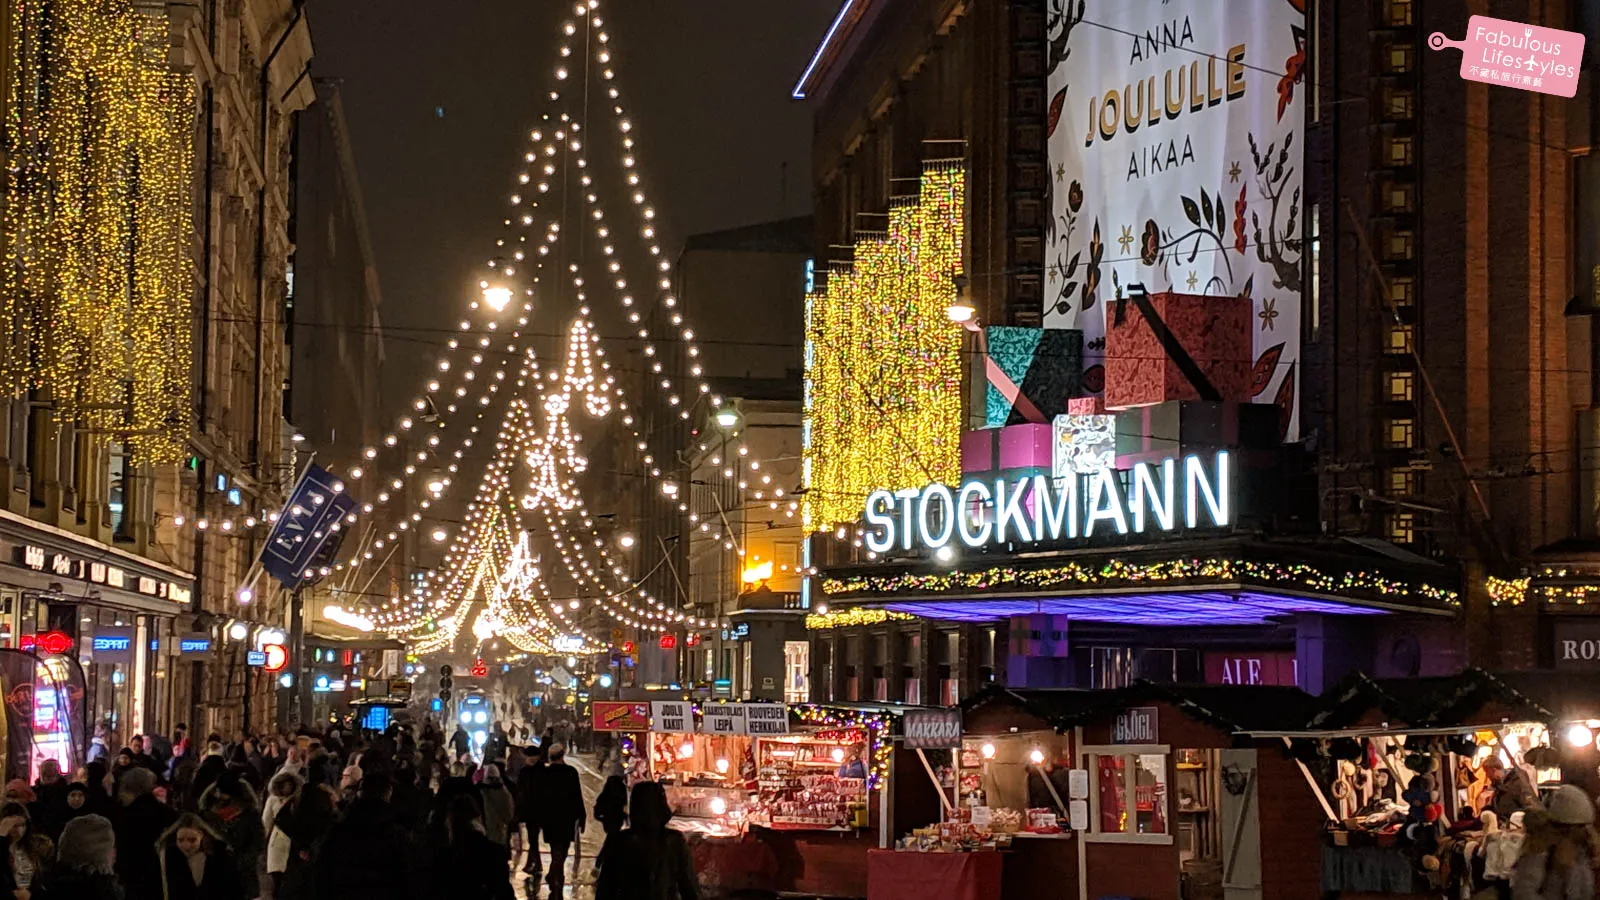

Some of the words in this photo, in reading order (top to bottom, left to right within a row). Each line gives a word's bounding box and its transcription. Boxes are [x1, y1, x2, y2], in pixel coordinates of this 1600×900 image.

[1130, 15, 1194, 65] ANNA
[1085, 43, 1247, 148] JOULULLE
[1127, 133, 1195, 182] AIKAA
[864, 450, 1230, 553] STOCKMANN
[94, 637, 131, 650] ESPRIT
[1561, 639, 1600, 660] RO
[1221, 657, 1263, 685] ALE
[661, 704, 683, 717] JOULU
[663, 718, 684, 731] KAKUT
[749, 720, 787, 734] HERKKUJA
[905, 721, 960, 738] MAKKARA
